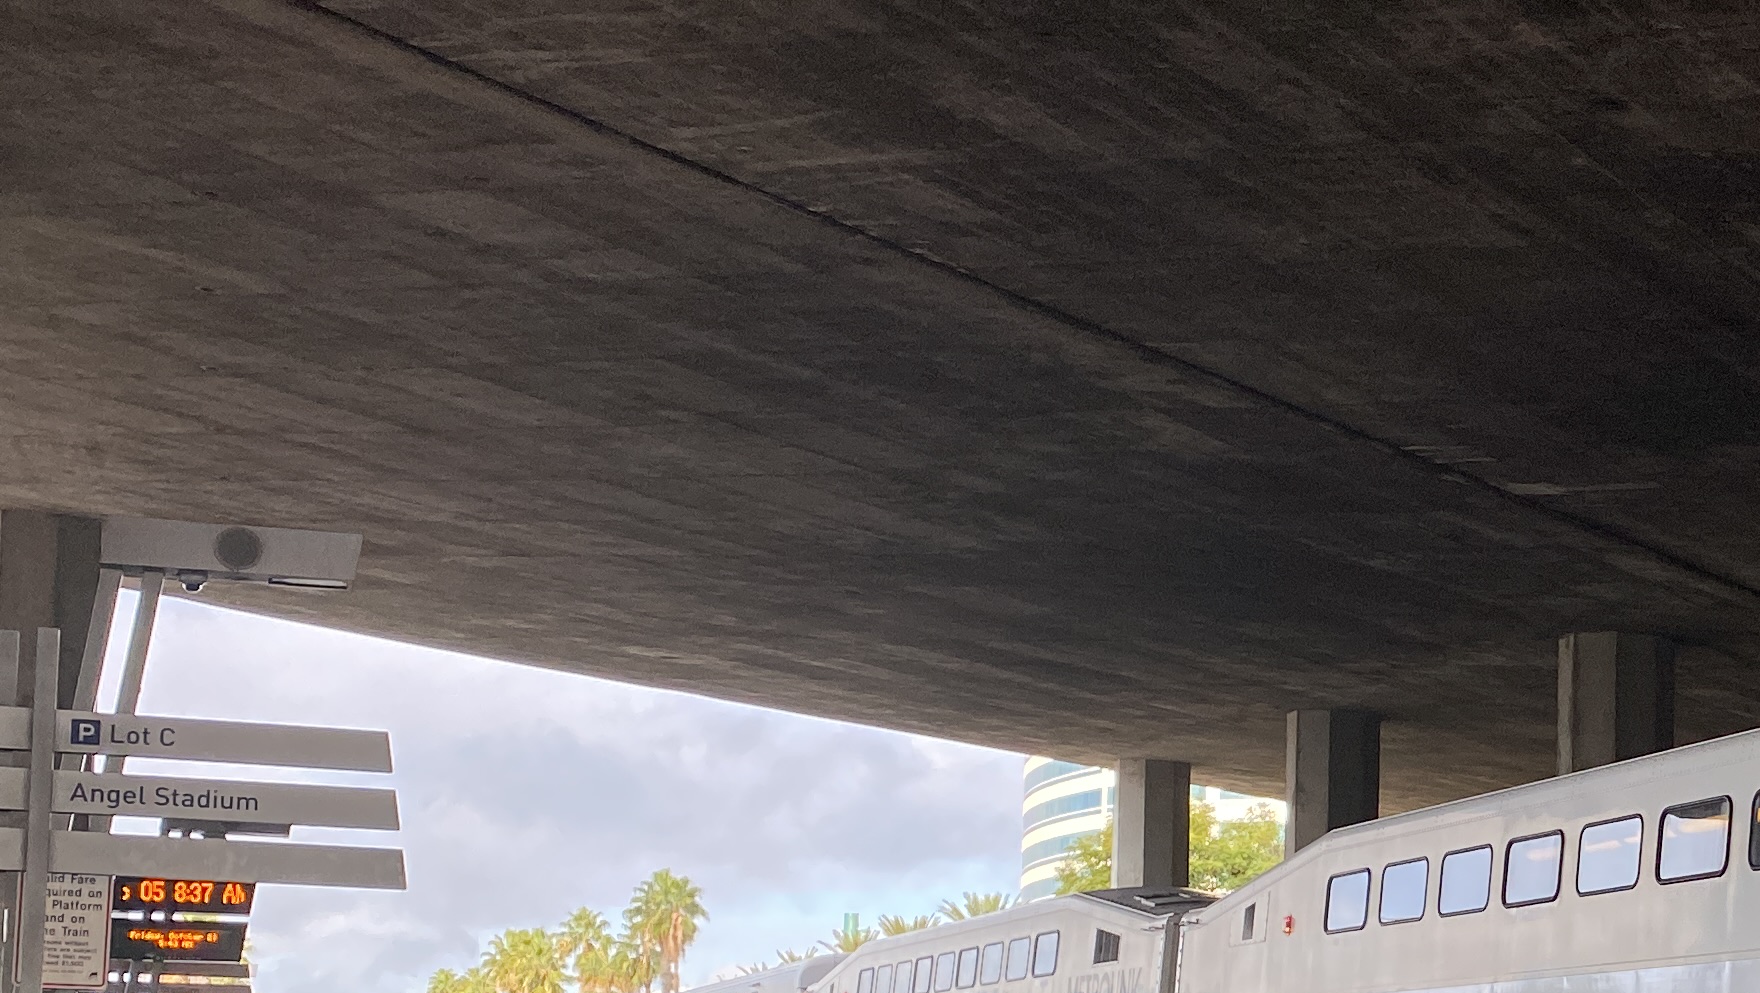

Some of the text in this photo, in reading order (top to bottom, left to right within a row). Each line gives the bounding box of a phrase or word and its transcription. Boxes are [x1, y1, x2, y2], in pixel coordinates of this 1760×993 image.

[111, 724, 150, 745] Lot
[159, 727, 176, 746] C
[70, 783, 259, 811] Angel Stadium
[71, 874, 96, 885] Fare
[139, 881, 165, 902] 05
[174, 881, 214, 903] 8:37
[52, 899, 103, 911] Platform
[71, 915, 85, 924] on
[61, 926, 89, 938] Train
